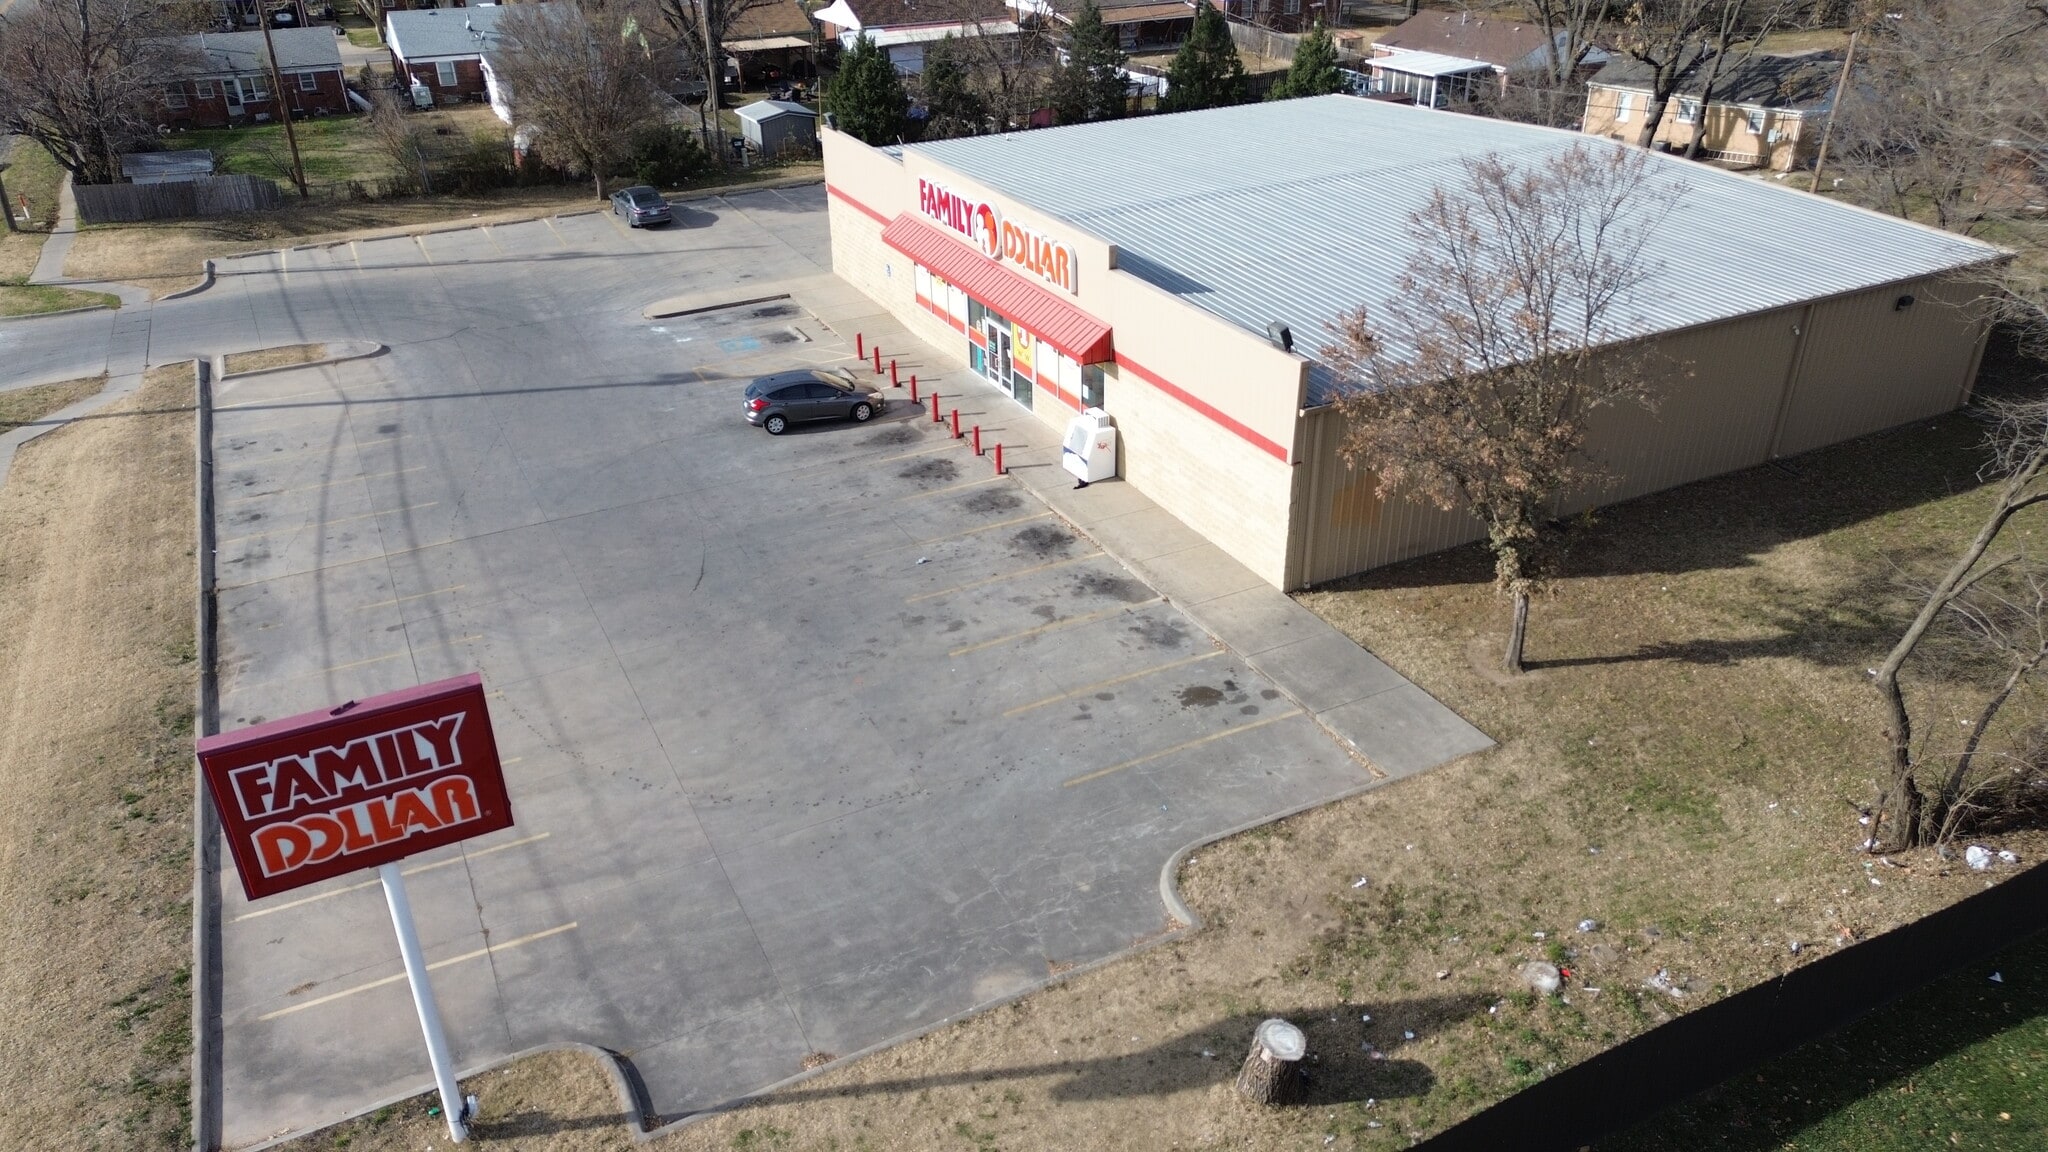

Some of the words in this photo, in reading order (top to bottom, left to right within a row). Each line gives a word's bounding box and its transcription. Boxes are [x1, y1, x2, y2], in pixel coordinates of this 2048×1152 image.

[919, 178, 973, 237] FAMILY
[1003, 220, 1069, 290] DOLLAR
[228, 711, 467, 821] FAMILY
[250, 774, 481, 878] DOLLAR
